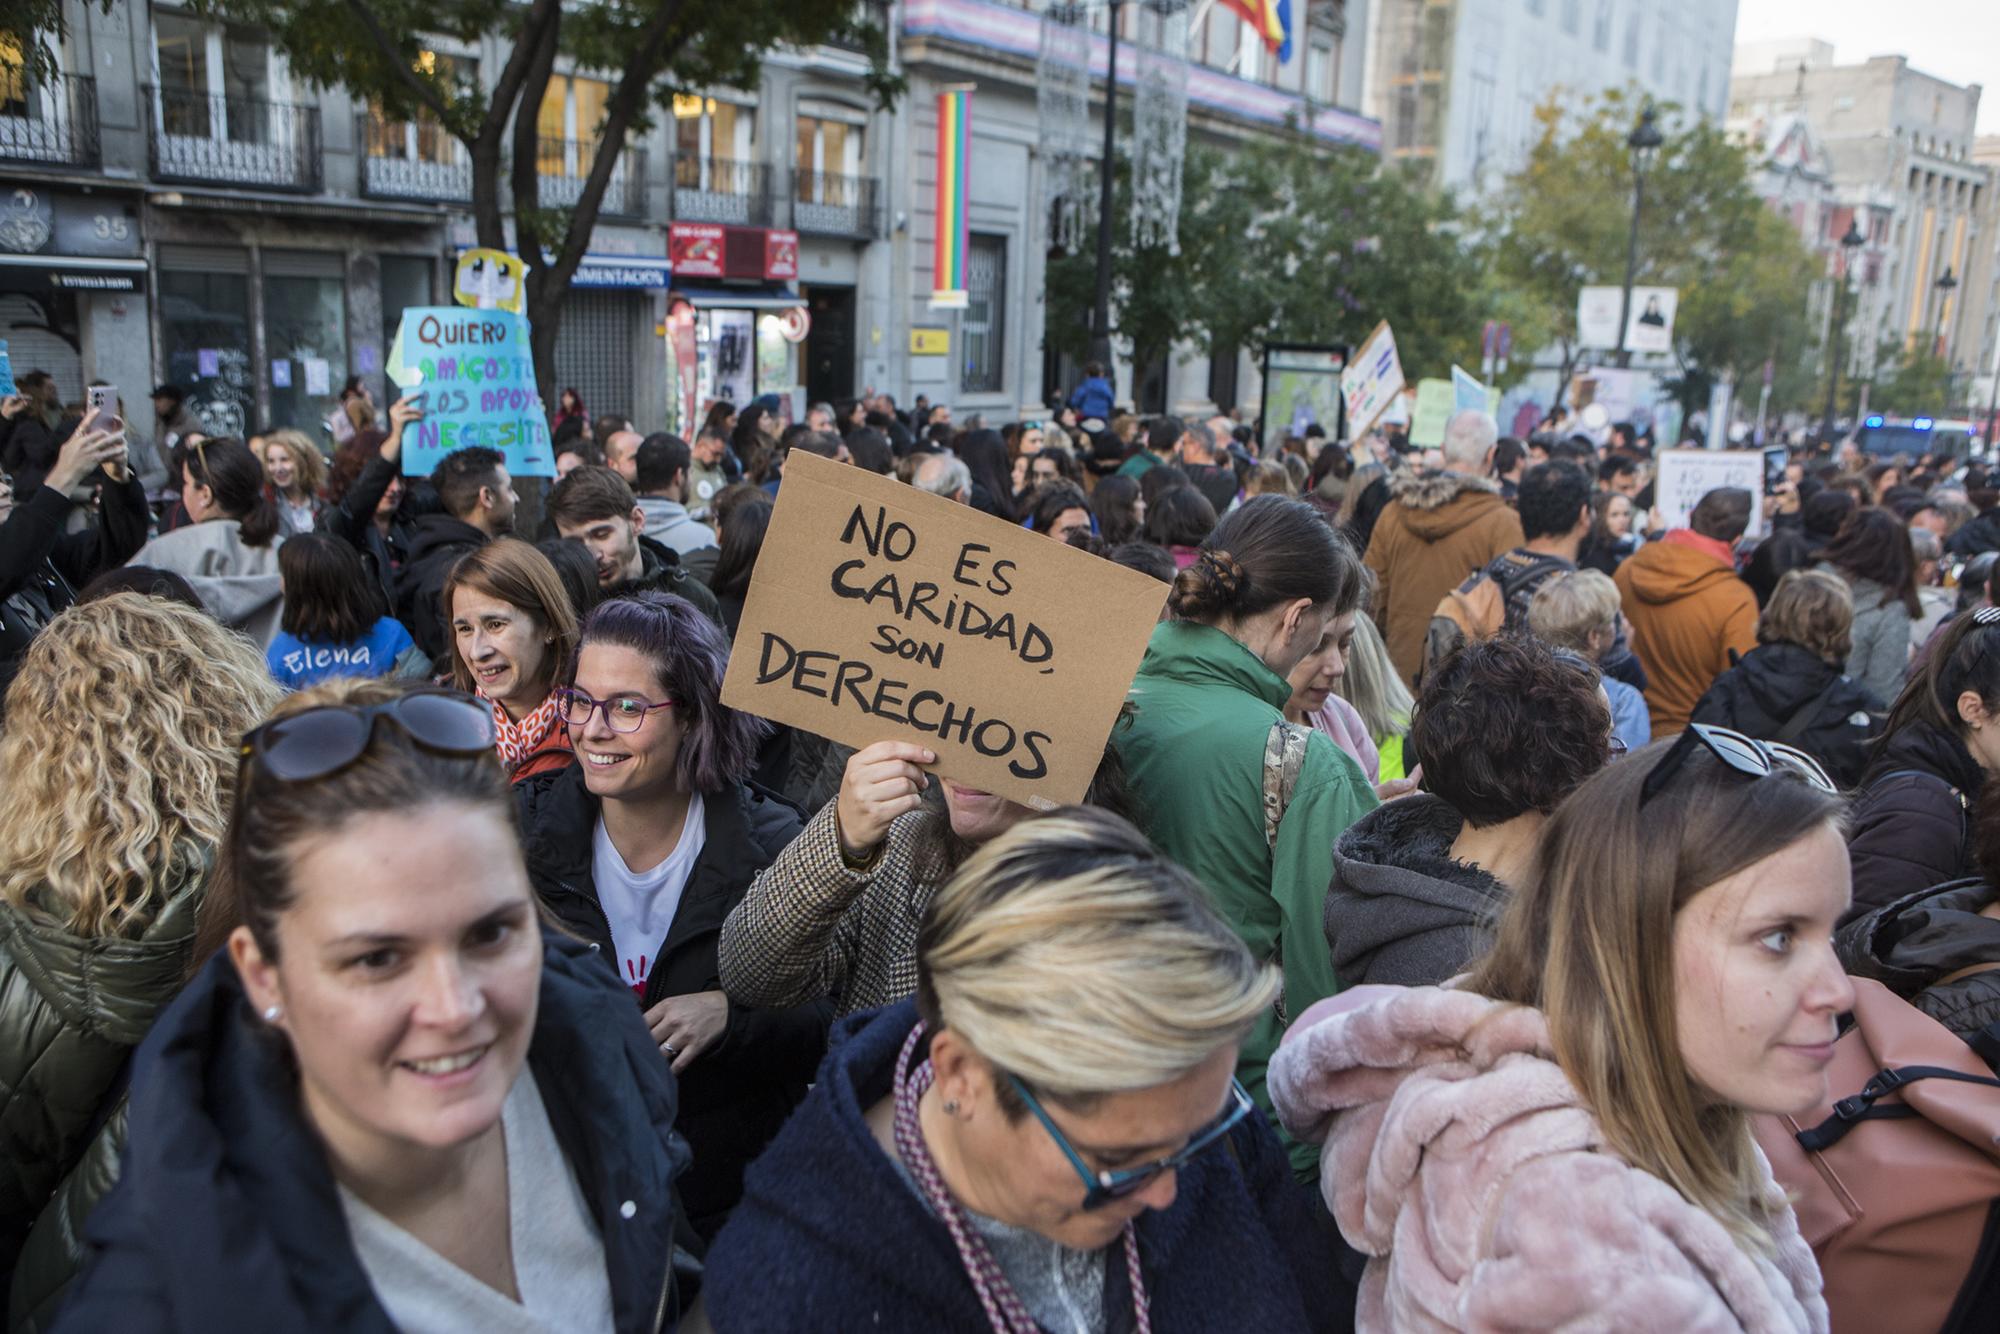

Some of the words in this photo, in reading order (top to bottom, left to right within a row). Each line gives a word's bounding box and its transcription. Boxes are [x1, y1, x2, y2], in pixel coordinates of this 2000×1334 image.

[94, 215, 128, 240] 35
[840, 503, 917, 561] NO
[953, 542, 1017, 596] ES
[283, 646, 370, 674] Elena
[870, 624, 945, 669] SON
[755, 632, 1053, 780] DERECHOS
